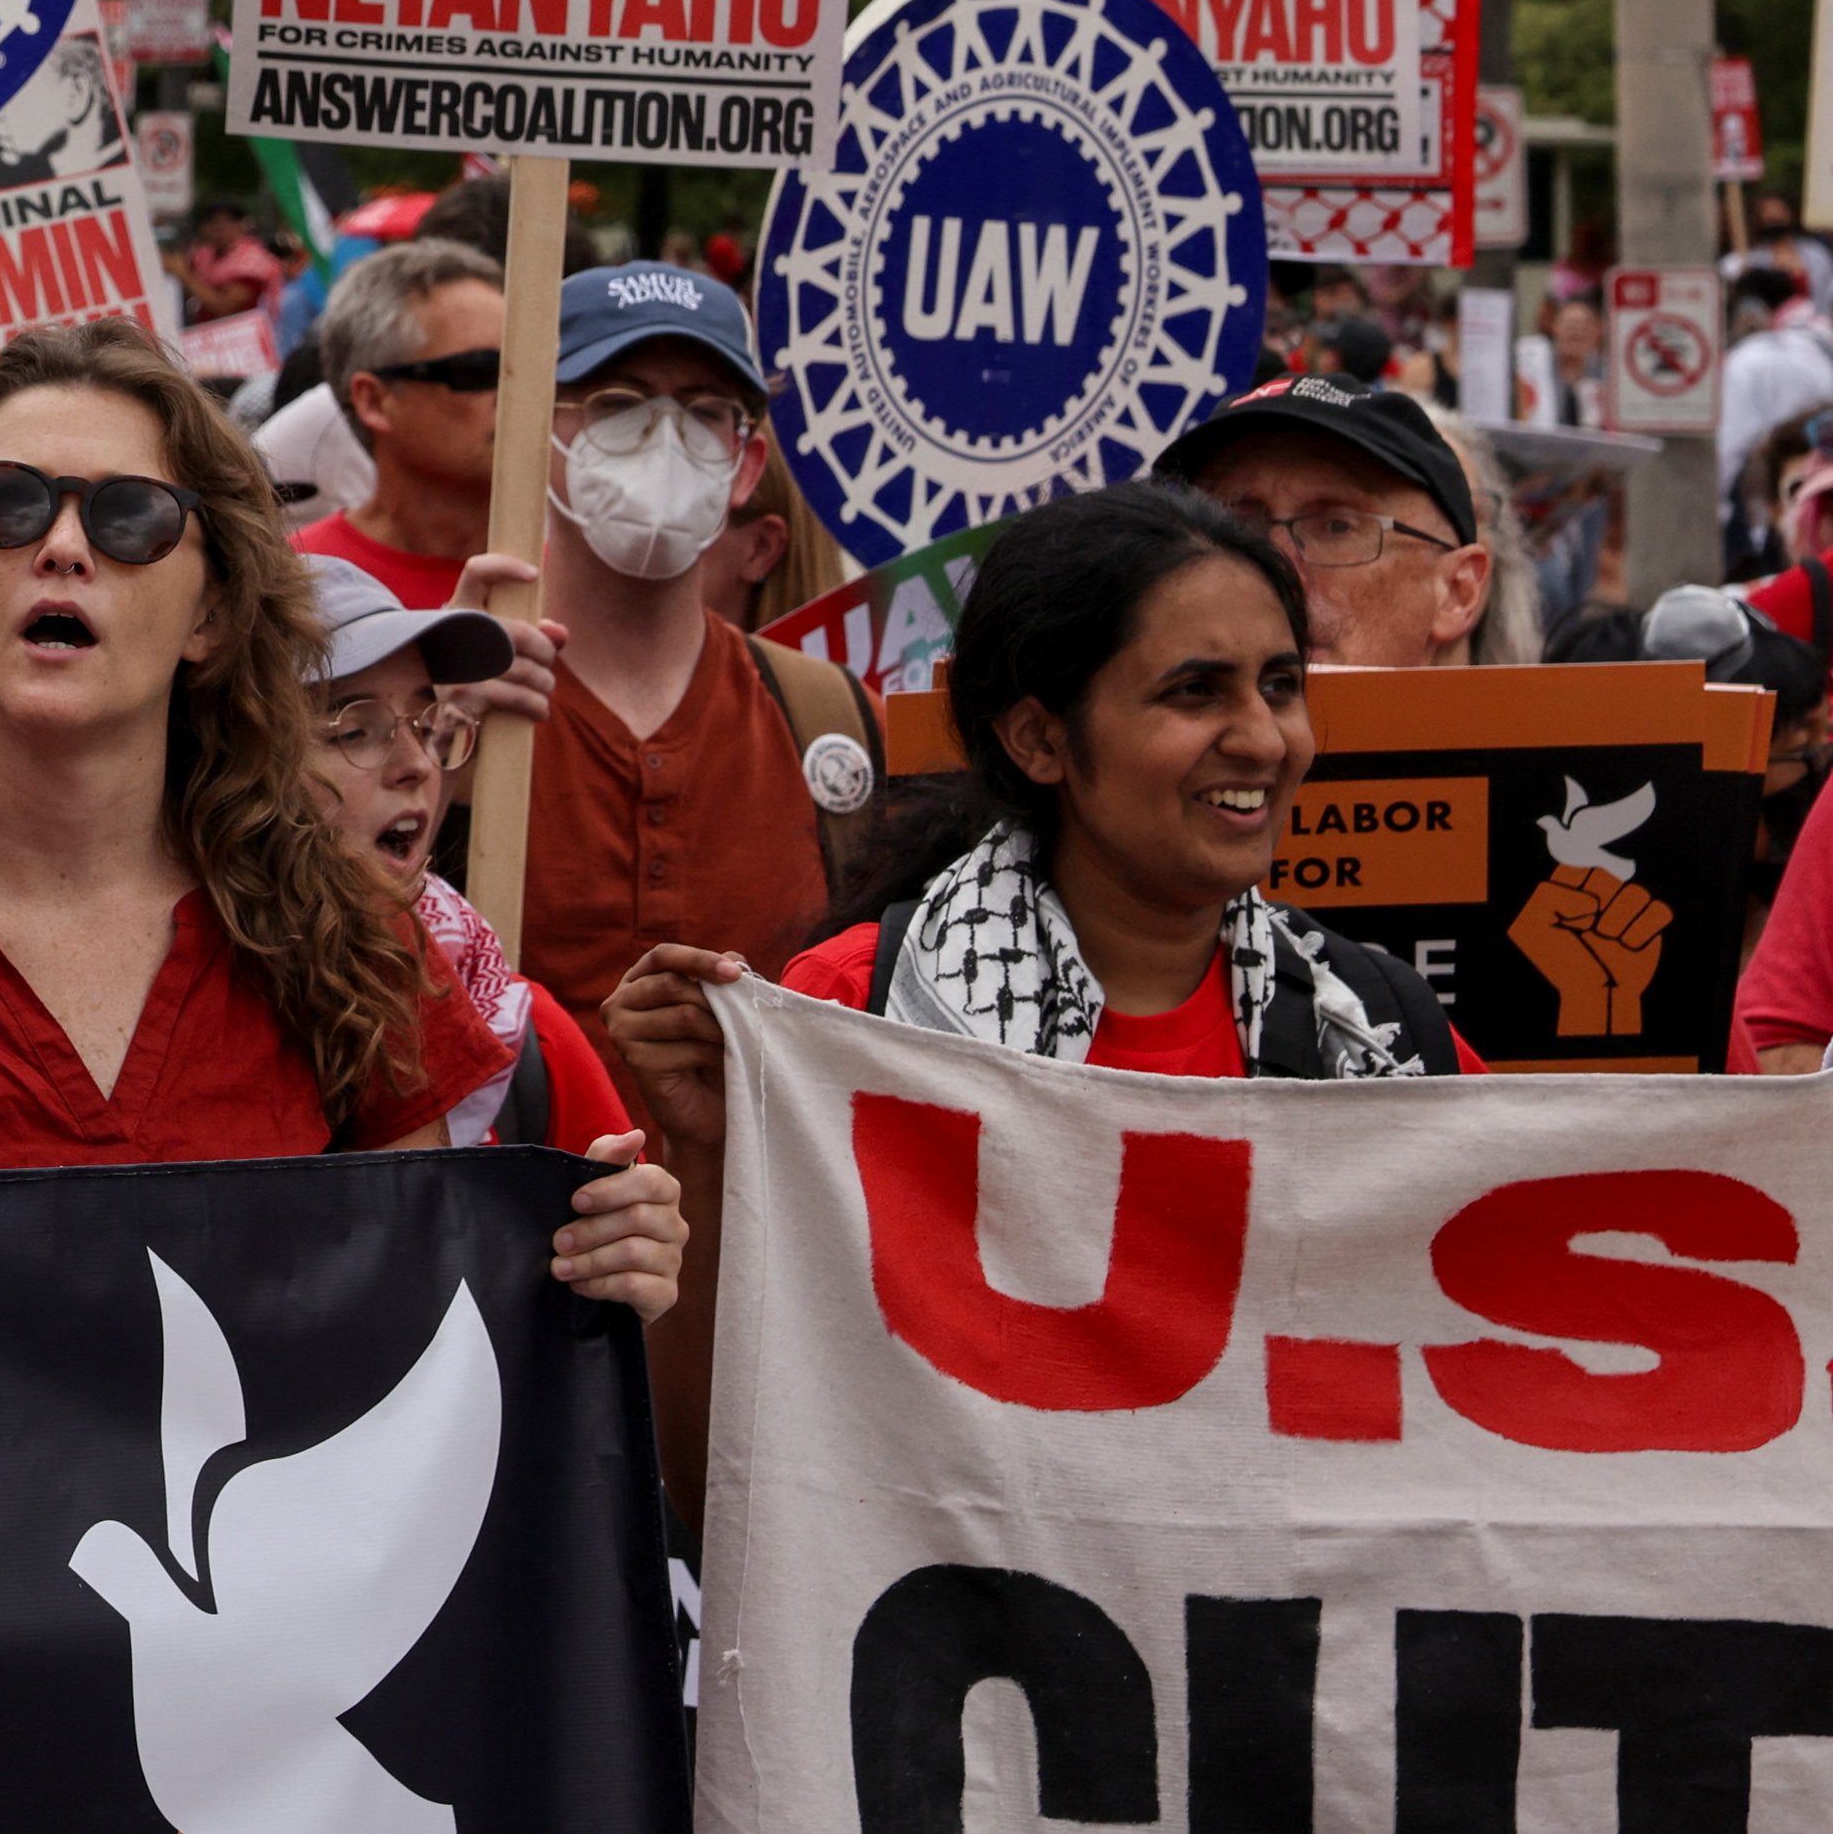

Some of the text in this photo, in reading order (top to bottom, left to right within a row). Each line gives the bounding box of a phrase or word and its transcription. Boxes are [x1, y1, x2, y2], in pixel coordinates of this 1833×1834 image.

[258, 25, 814, 73] FOR CRIMES AGAINST HUMANITY
[1252, 69, 1396, 86] HUMANITY
[250, 68, 813, 157] ANSWERCOALITION.ORG
[934, 82, 972, 113] AND
[980, 73, 1098, 118] AGRICULTURAL
[860, 113, 927, 221] AEROSPACE
[1101, 119, 1156, 230] IMPLEMENT
[903, 216, 1100, 346] UAW
[1136, 240, 1162, 350] WORKERS
[867, 386, 915, 451] UNITED
[1291, 801, 1453, 836] LABOR
[1270, 857, 1363, 889] FOR
[851, 1090, 1833, 1453] U.S
